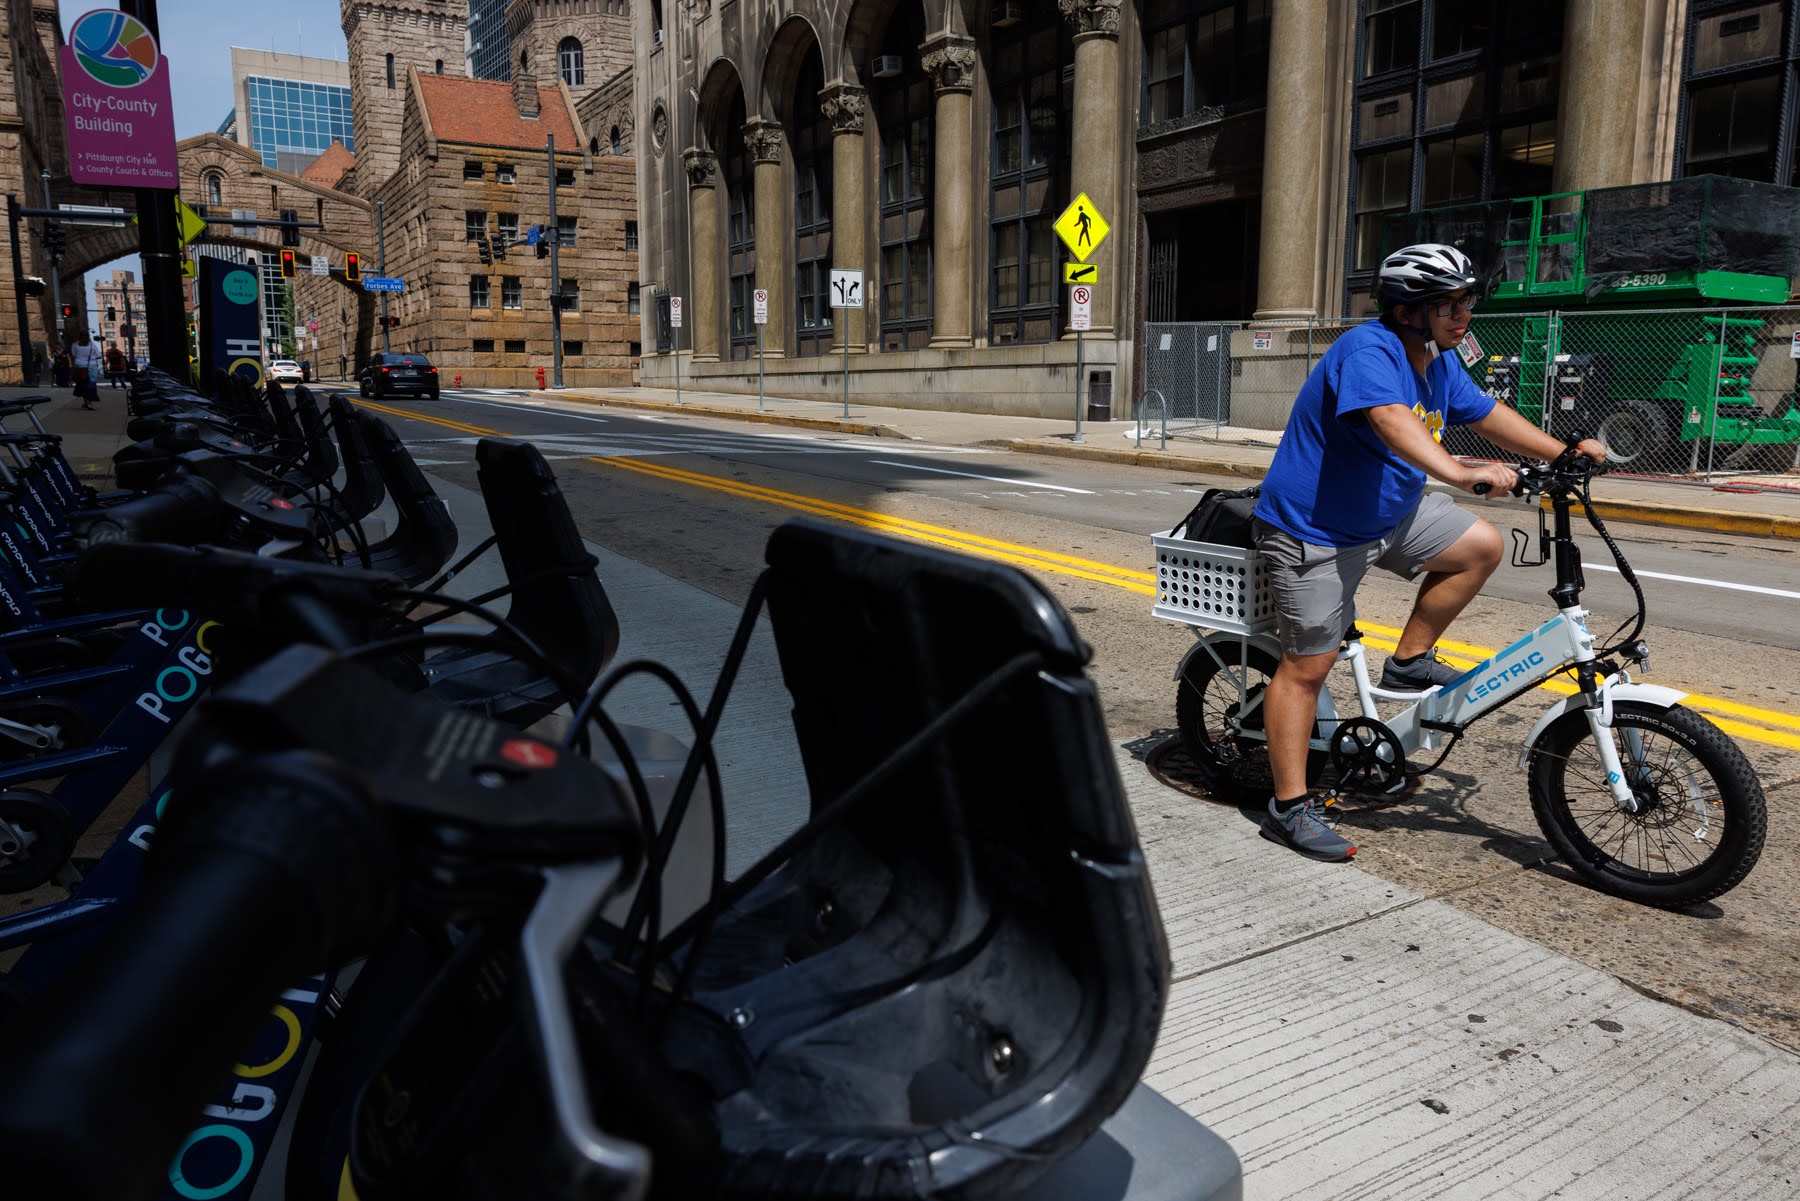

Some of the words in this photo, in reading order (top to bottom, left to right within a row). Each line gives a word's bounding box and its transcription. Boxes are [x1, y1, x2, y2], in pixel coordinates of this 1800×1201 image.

[73, 93, 157, 117] City-County
[75, 116, 132, 137] Building
[86, 153, 124, 164] Pittsburgh
[126, 156, 141, 165] City
[87, 165, 113, 175] County
[116, 167, 140, 175] Courts
[149, 169, 173, 177] Offices
[20, 506, 49, 551] 35907
[2, 532, 38, 583] 35921
[1465, 651, 1544, 704] LECTRIC
[1614, 713, 1660, 726] LECTRIC
[1661, 721, 1697, 746] 20x3.0
